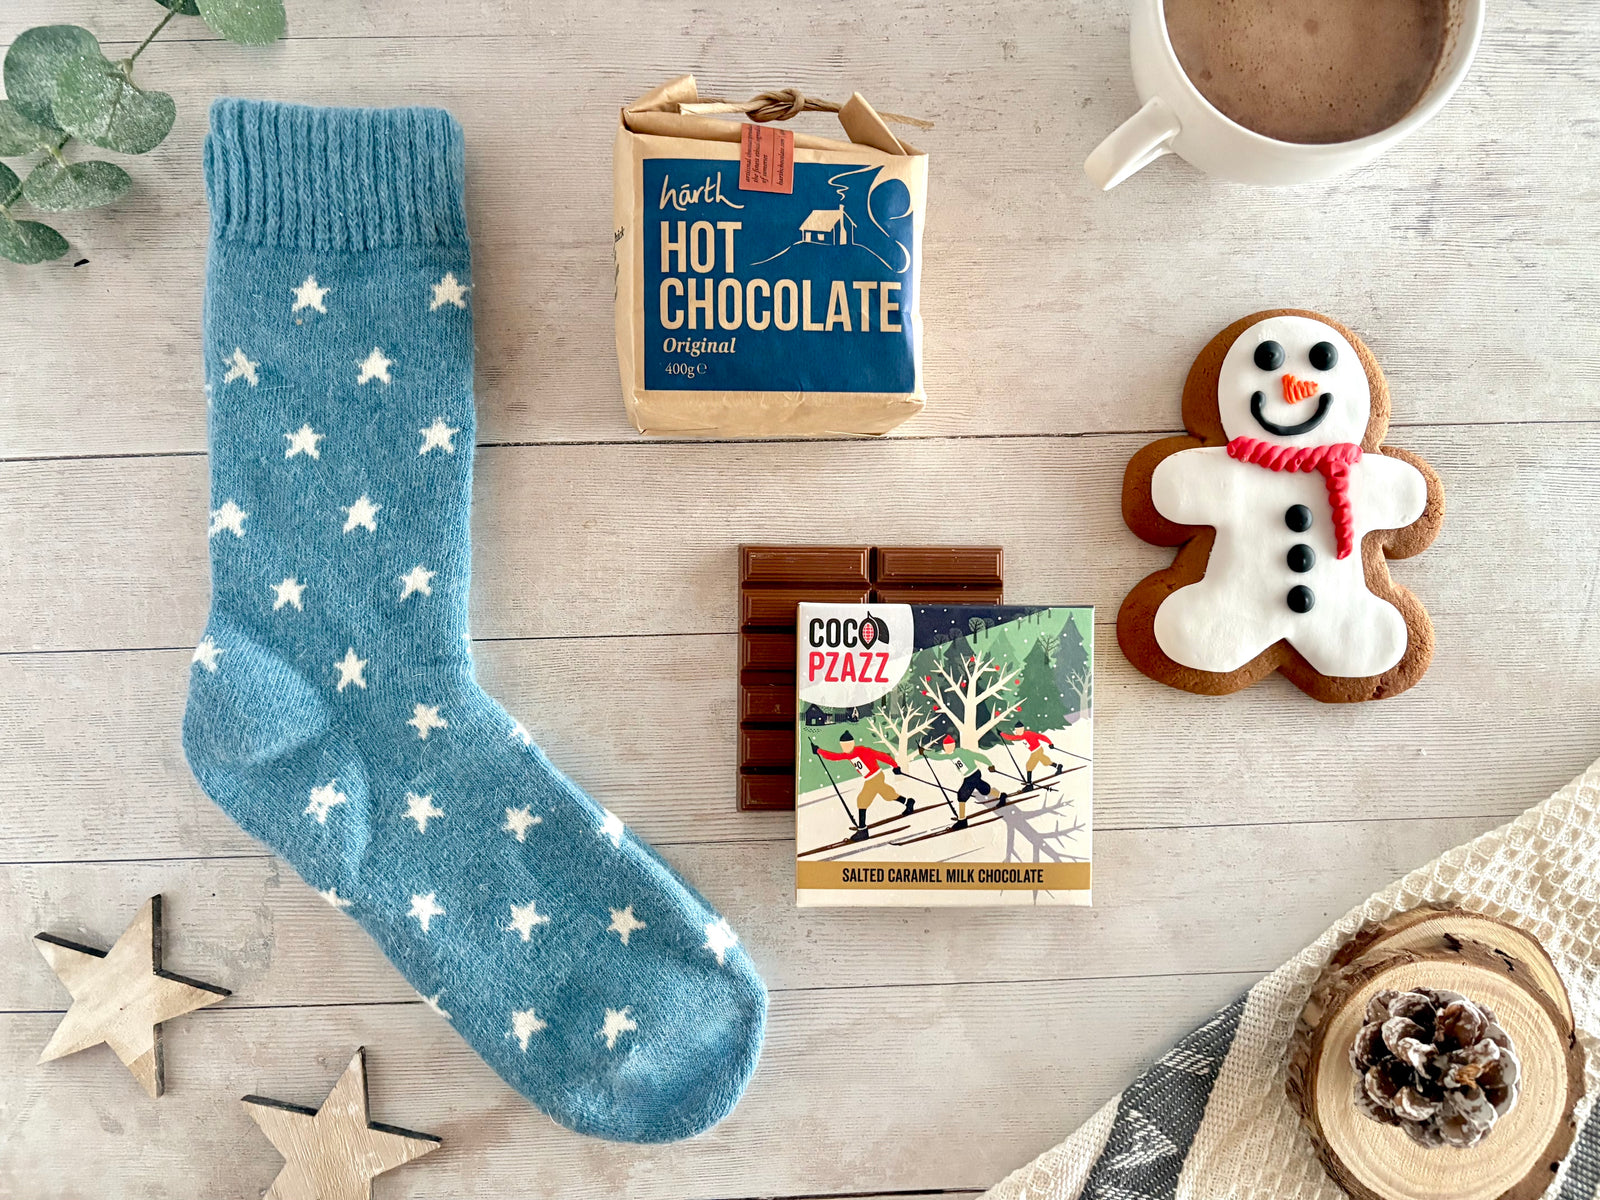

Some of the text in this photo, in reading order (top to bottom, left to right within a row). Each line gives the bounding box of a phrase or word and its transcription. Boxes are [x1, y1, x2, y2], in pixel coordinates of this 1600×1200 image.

[660, 221, 742, 273] HOT
[659, 277, 902, 332] CHOCOLATE
[663, 337, 737, 357] Original
[808, 651, 889, 683] PZAZZ
[842, 867, 1044, 883] SALTED CARAMEL MILK CHOCOLATE
